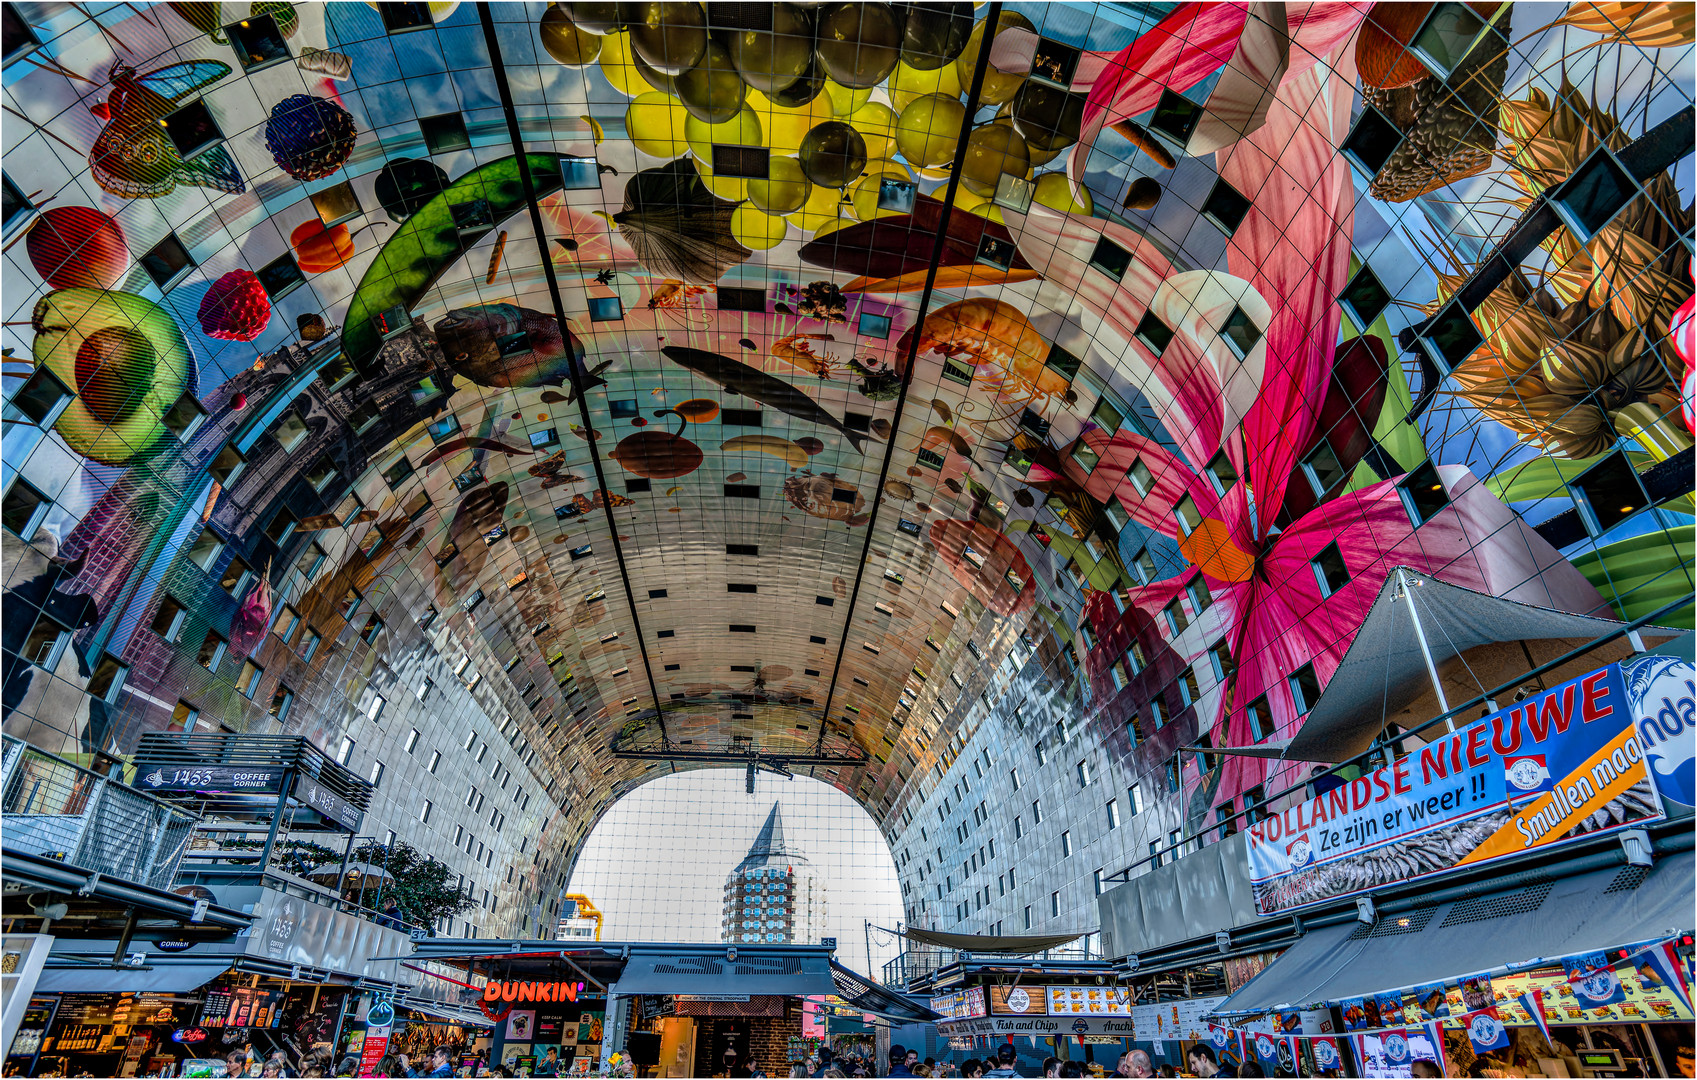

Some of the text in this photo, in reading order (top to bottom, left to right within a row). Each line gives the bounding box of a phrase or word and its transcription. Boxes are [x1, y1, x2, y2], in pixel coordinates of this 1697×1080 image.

[1251, 668, 1614, 849] HOLLANDSE NIEUWE
[172, 770, 214, 785] 1453
[233, 773, 271, 781] COFFEE
[342, 805, 360, 821] COFFEE
[1320, 773, 1486, 852] Ze zijn er weer !!
[1515, 776, 1596, 847] Smullen
[271, 917, 294, 939] 1453
[270, 939, 285, 949] COFFEE
[1565, 955, 1607, 971] Broodjes
[484, 981, 584, 1002] DUNKIN'
[996, 1019, 1014, 1030] Fish
[1015, 1019, 1033, 1030] and
[1035, 1019, 1058, 1032] Chips
[183, 1028, 207, 1042] Coffee
